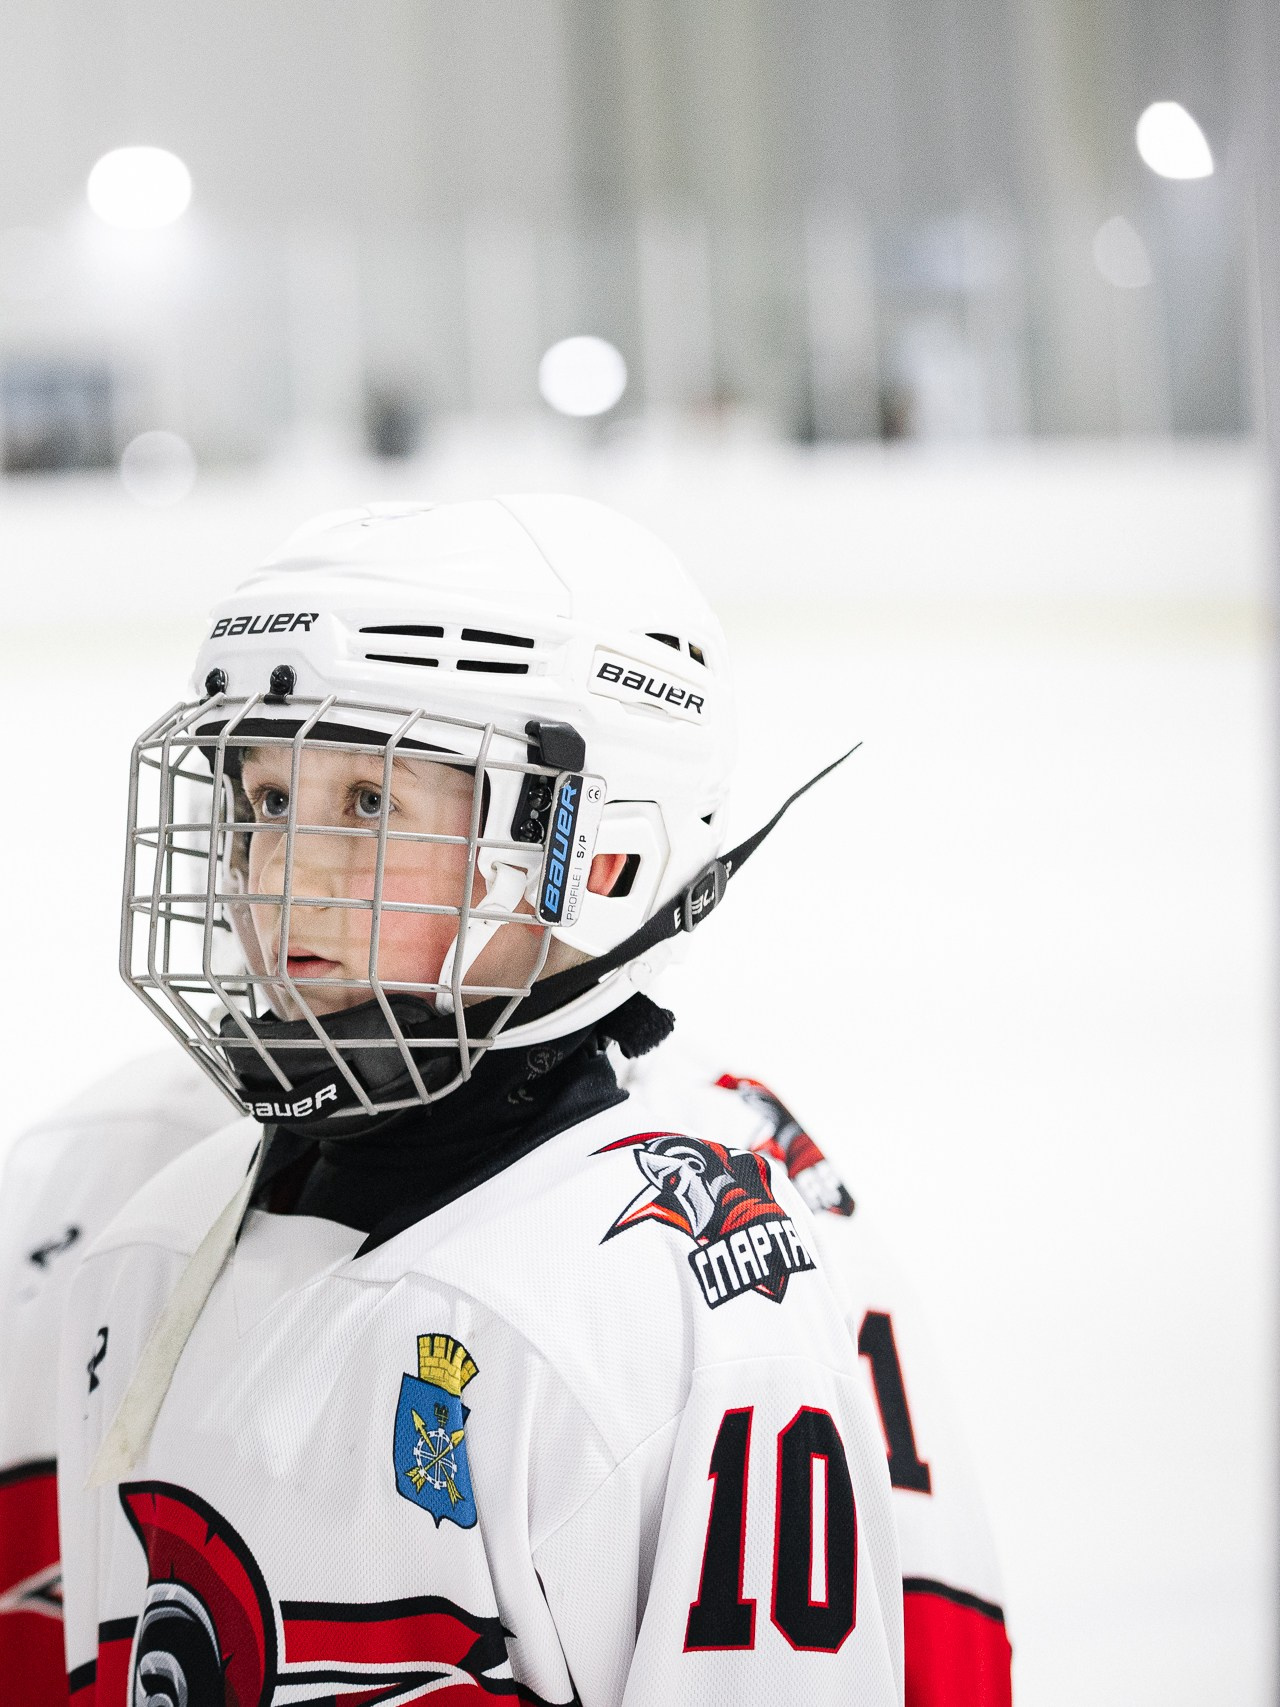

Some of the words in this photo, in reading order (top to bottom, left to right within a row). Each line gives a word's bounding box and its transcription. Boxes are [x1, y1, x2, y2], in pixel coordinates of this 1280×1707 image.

[209, 612, 320, 639] BAUER
[596, 662, 705, 714] BAUER
[544, 782, 577, 914] BAUER
[566, 874, 582, 921] PROFILE
[682, 1405, 858, 1654] 10
